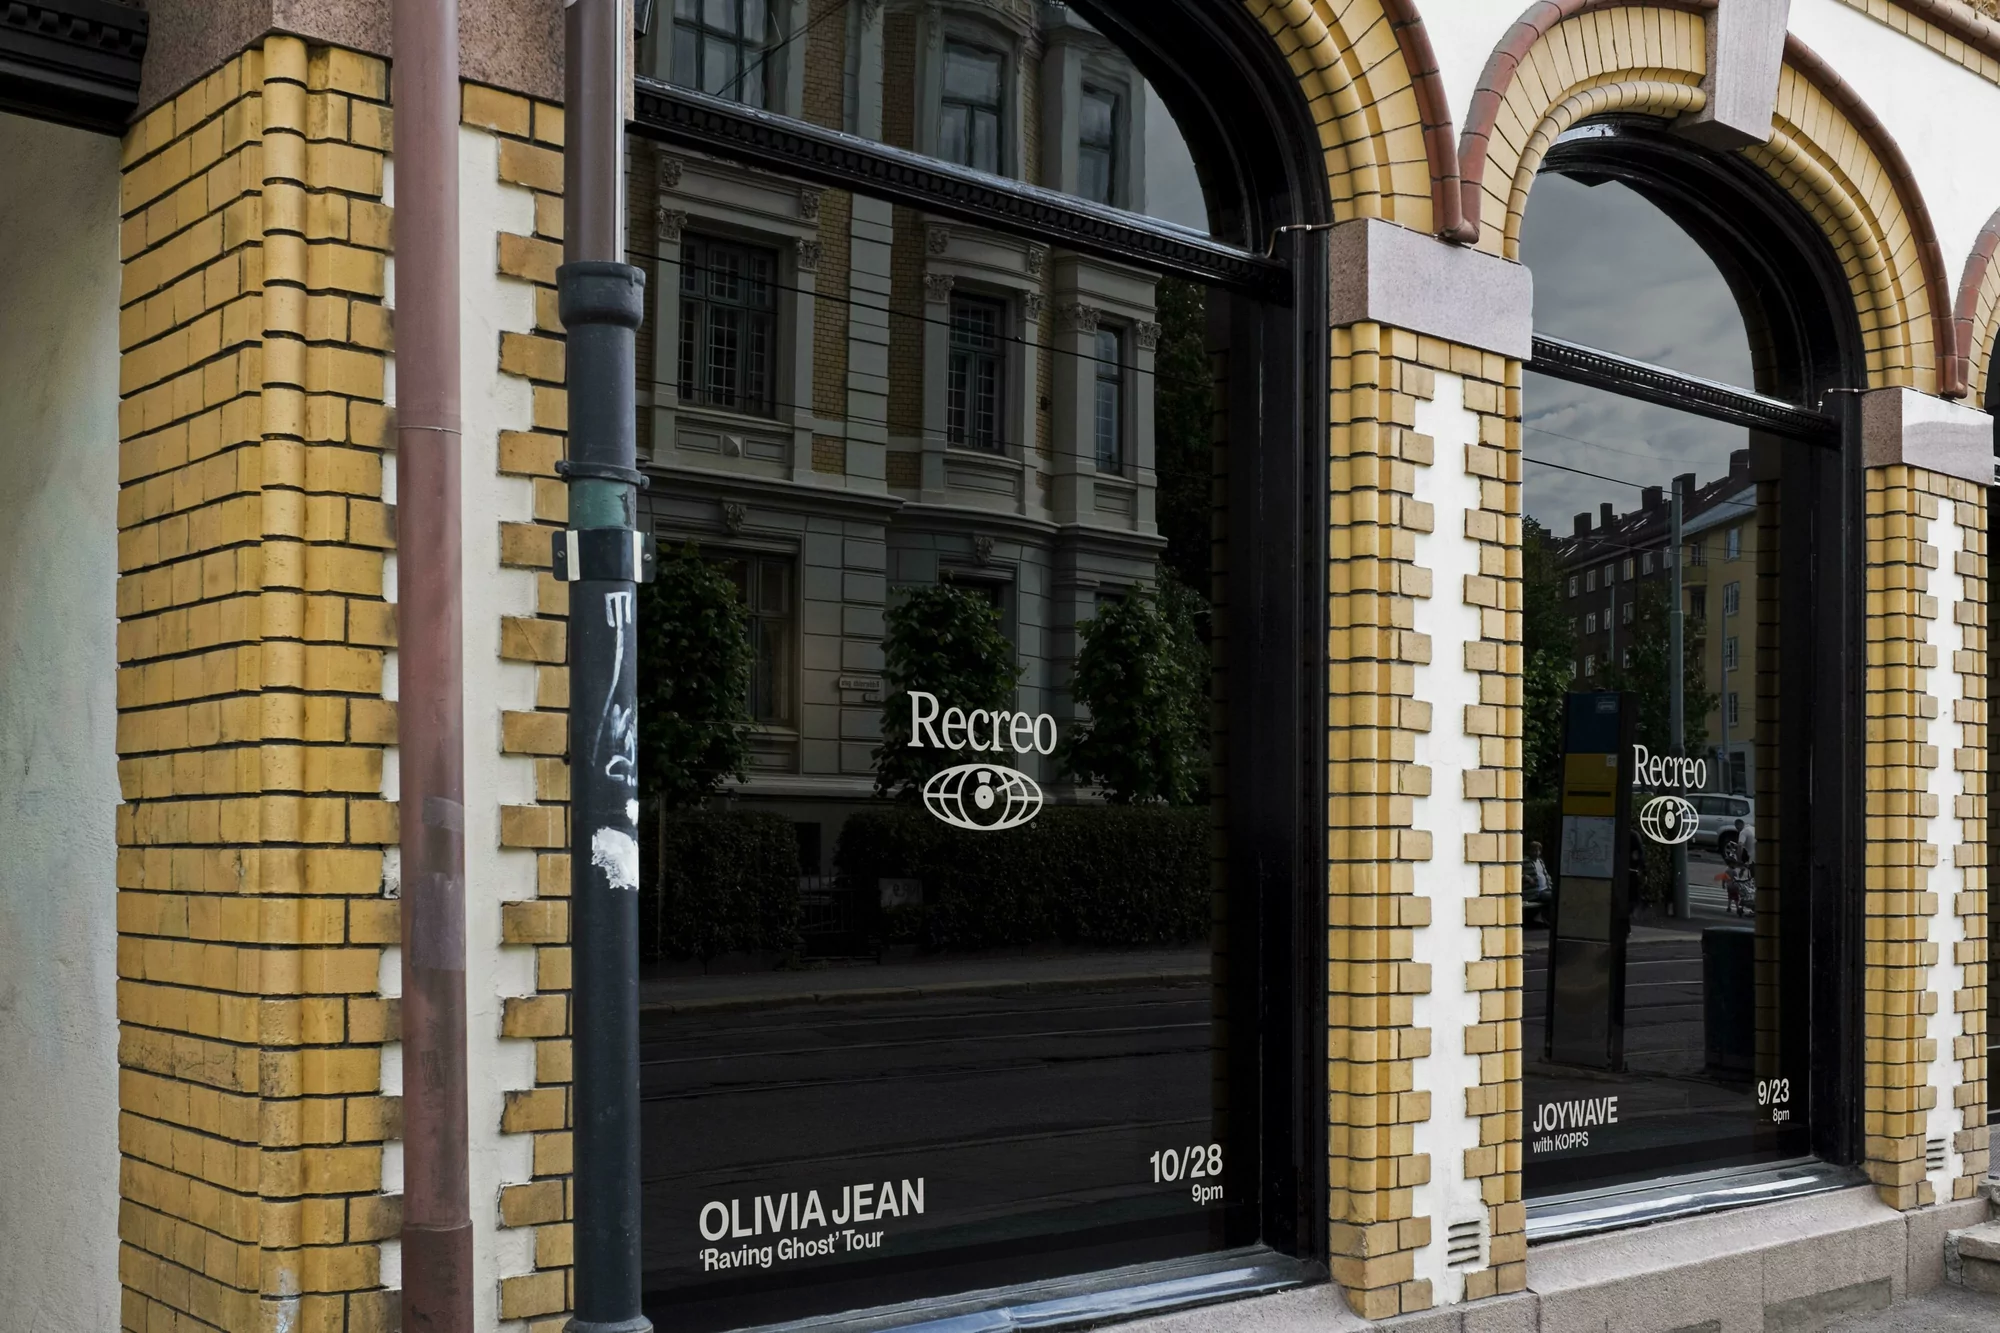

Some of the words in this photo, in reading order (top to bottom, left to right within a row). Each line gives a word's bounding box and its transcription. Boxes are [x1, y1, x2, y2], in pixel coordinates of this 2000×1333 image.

[907, 690, 1058, 755] Recreo
[1632, 744, 1707, 789] Recreo
[1757, 1078, 1790, 1106] 9/23
[1532, 1096, 1619, 1133] JOYWAVE
[1772, 1107, 1790, 1125] 8pm
[1532, 1136, 1554, 1154] with
[1554, 1131, 1589, 1151] KOPPS
[1149, 1143, 1223, 1184] 10/28
[699, 1189, 828, 1242] OLIVIA
[831, 1177, 925, 1225] JEAN
[1191, 1184, 1224, 1206] 9pm
[699, 1243, 773, 1272] ‘Raving
[777, 1230, 840, 1261] Ghost’
[841, 1228, 884, 1252] Tour
